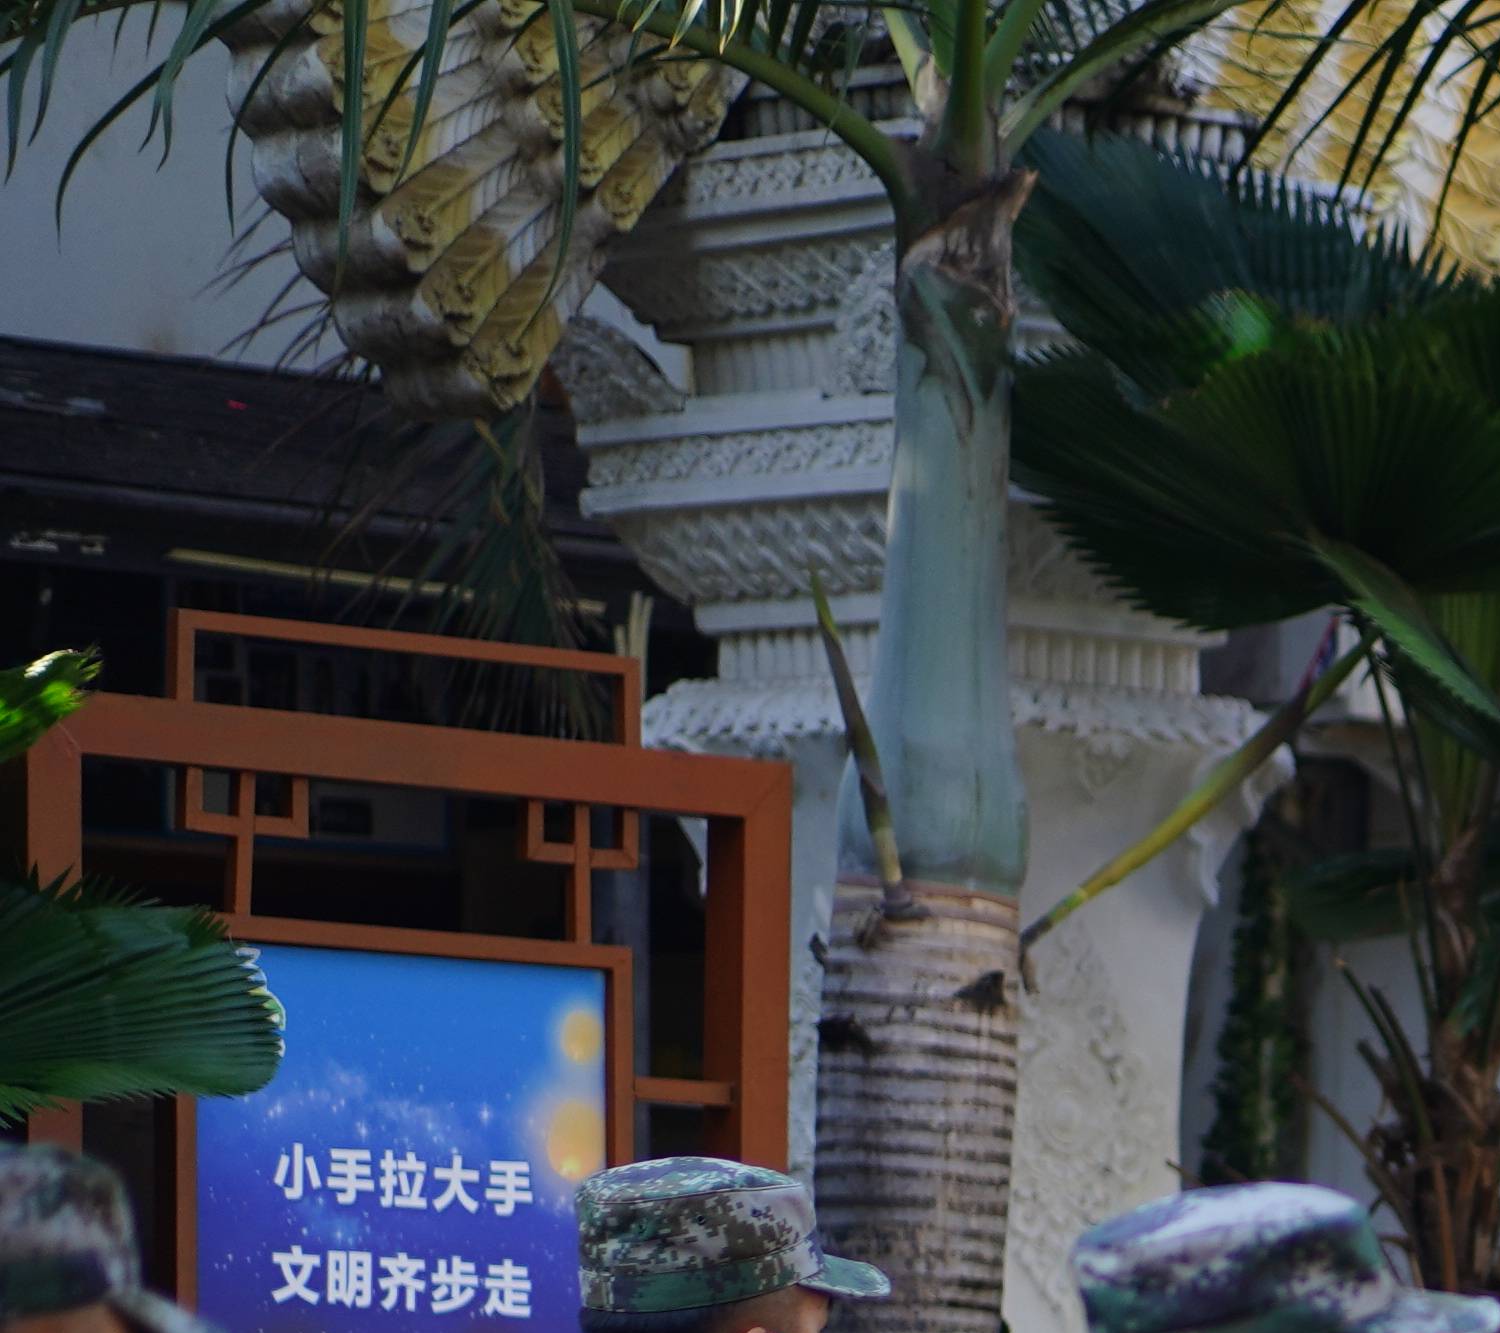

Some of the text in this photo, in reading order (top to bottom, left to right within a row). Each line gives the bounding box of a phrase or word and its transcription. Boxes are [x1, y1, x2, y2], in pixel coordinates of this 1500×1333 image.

[273, 1142, 534, 1217] 小手拉大手
[271, 1244, 533, 1318] 文明齐步走
